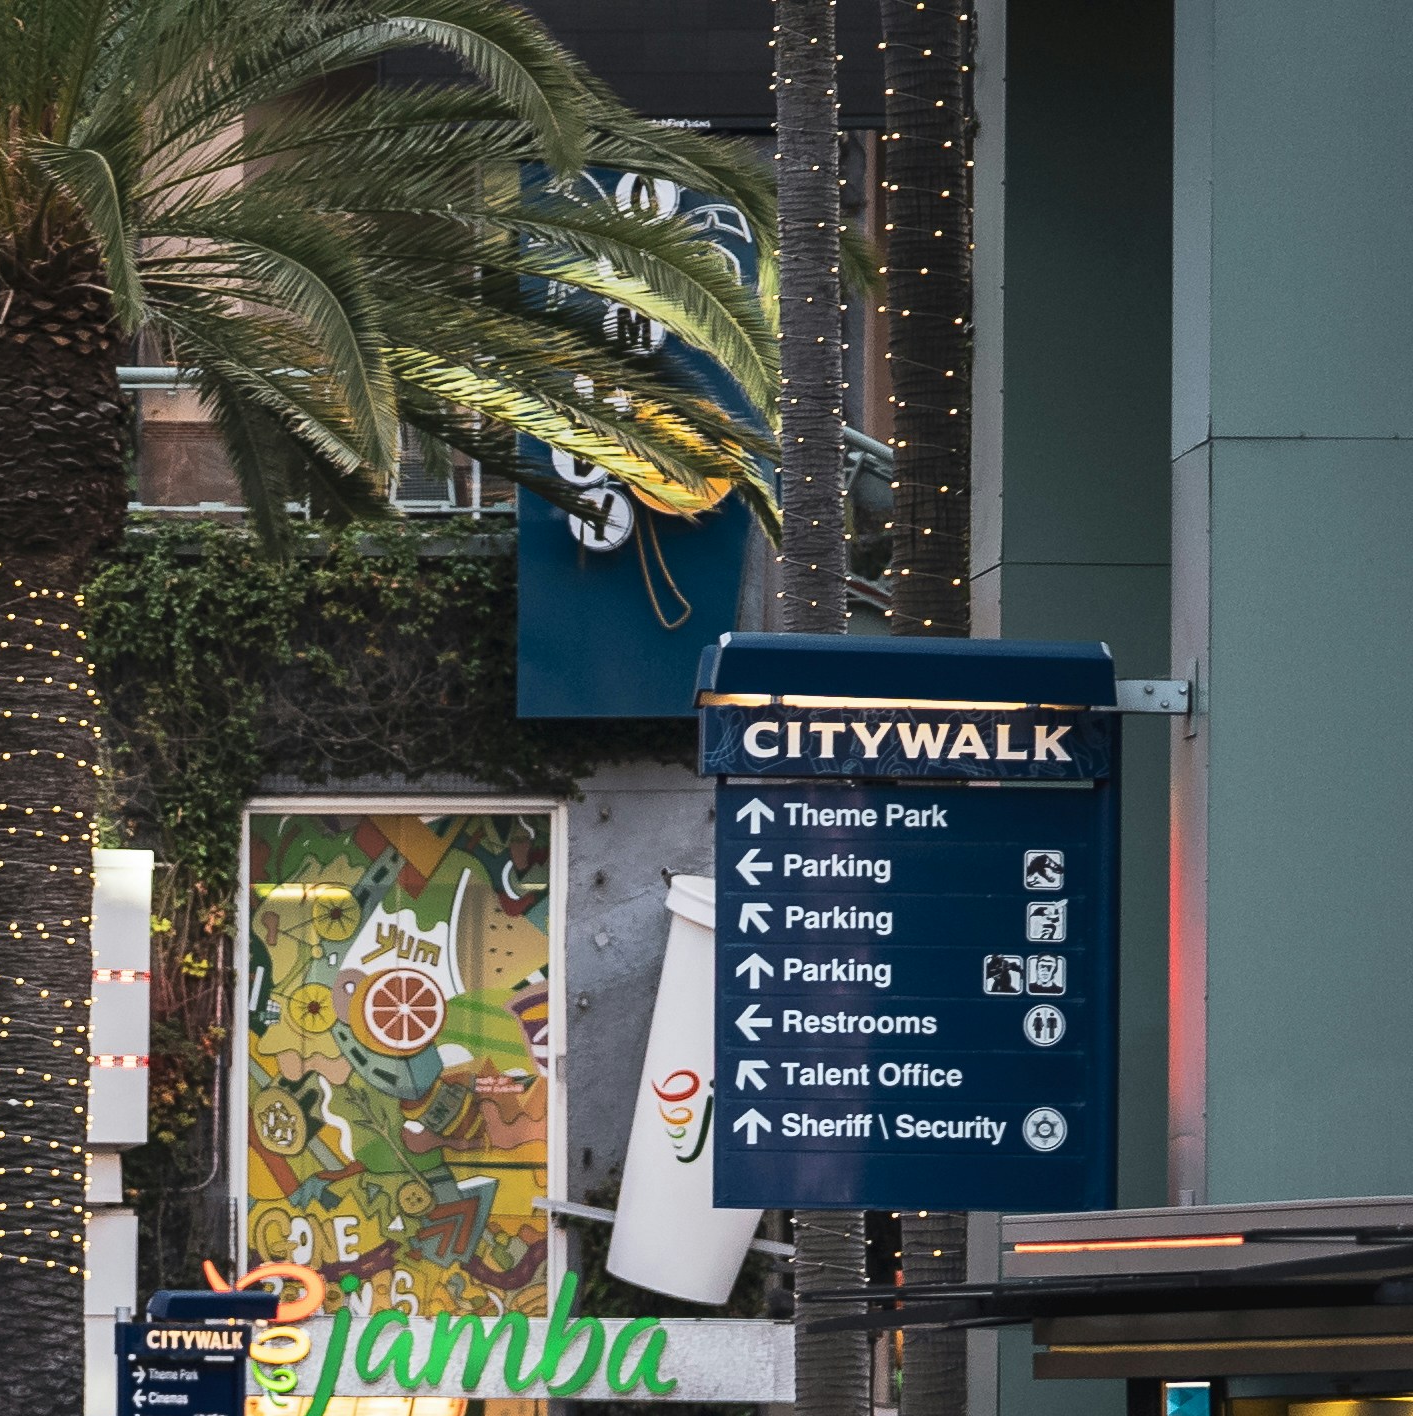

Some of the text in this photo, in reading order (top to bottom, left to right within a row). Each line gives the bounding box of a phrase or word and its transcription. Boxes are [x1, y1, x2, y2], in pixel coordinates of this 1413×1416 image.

[743, 721, 1072, 762] CITYWALK
[784, 803, 948, 829] Theme Park
[783, 854, 891, 883] Parking
[785, 906, 893, 935] Parking
[783, 958, 892, 988] Parking
[782, 1010, 937, 1035] Restrooms
[781, 1062, 963, 1087] Talent Office
[782, 1113, 872, 1139] Sheriff
[896, 1116, 1007, 1145] Security
[146, 1330, 244, 1350] CITYWALK
[149, 1368, 199, 1381] Theme Park
[148, 1392, 189, 1405] Cinemas
